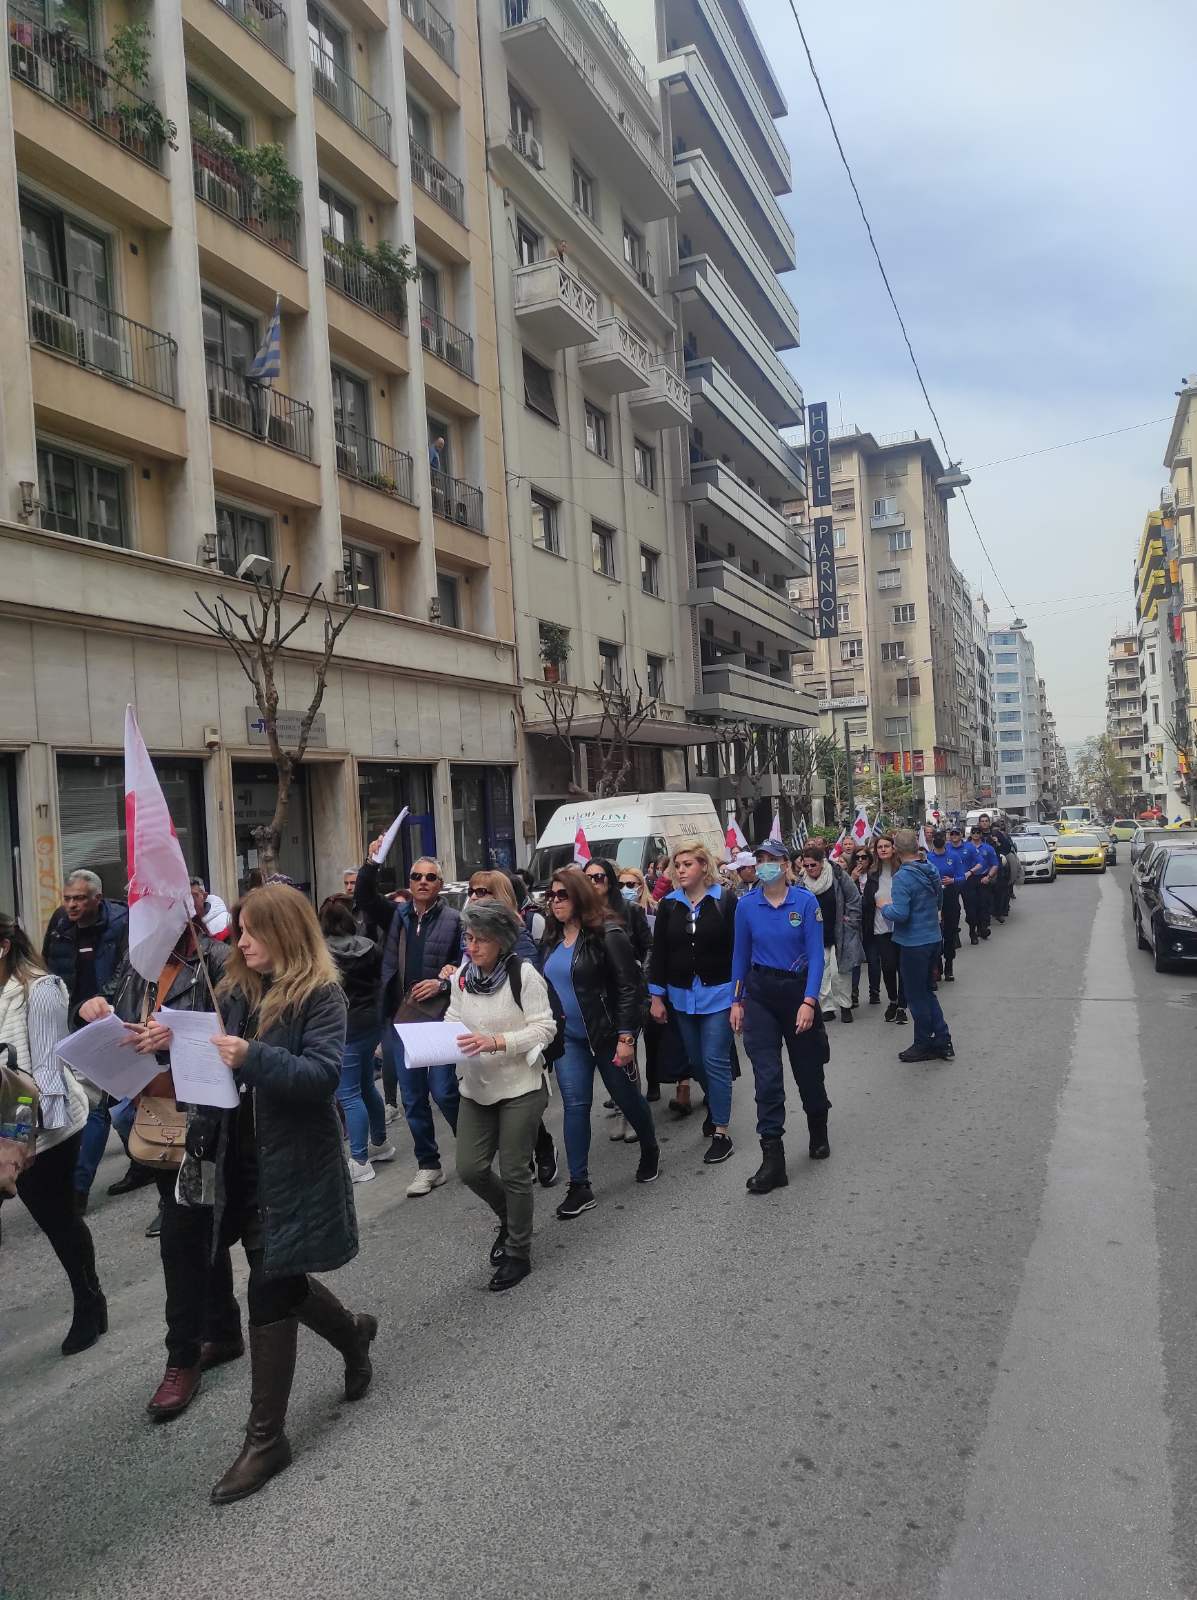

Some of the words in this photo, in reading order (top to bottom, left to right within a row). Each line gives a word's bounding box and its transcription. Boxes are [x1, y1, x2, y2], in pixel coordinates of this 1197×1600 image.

[812, 411, 826, 498] HOTEL
[819, 525, 835, 630] PARNON
[36, 804, 48, 818] 17
